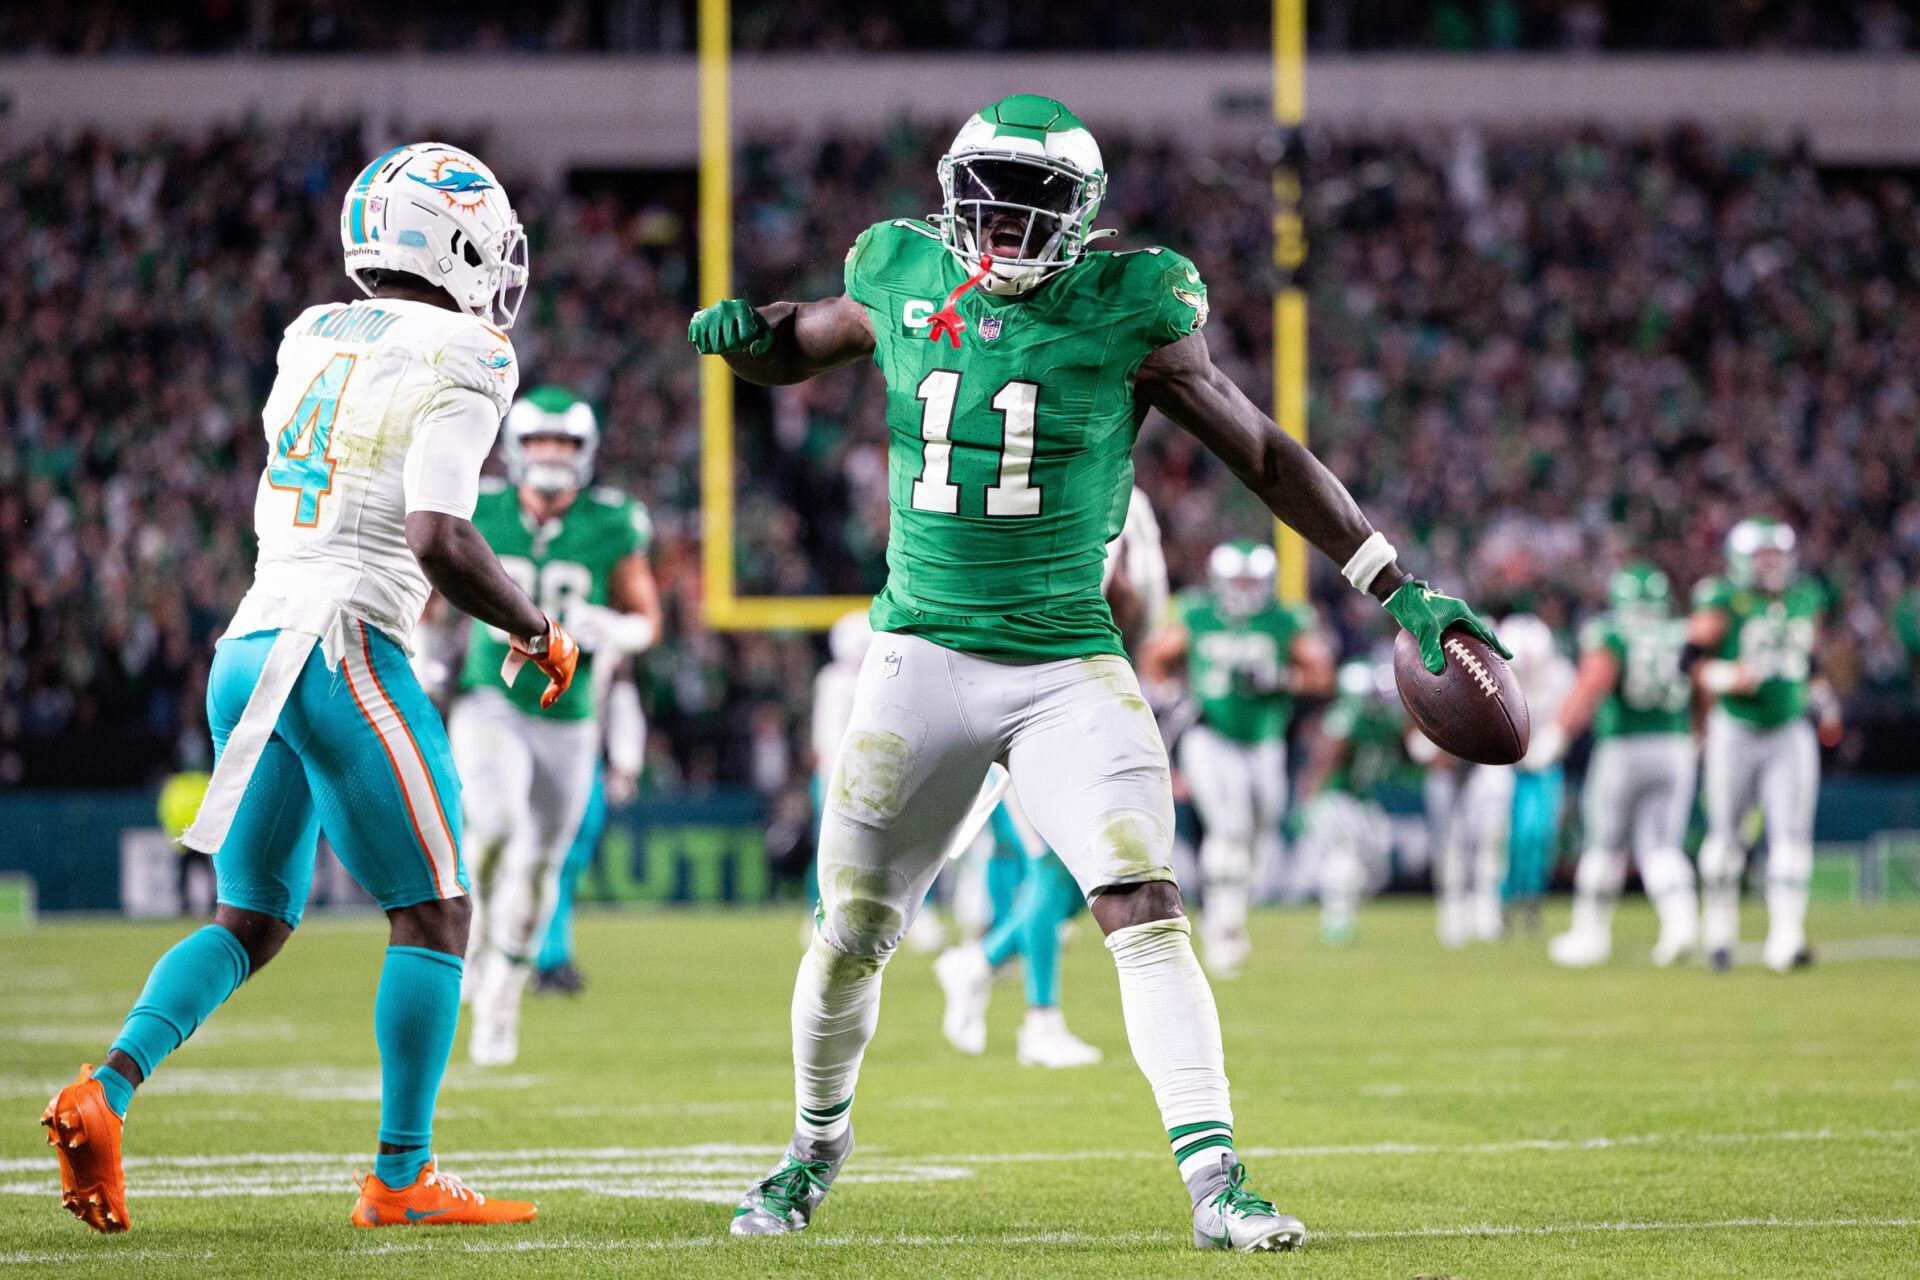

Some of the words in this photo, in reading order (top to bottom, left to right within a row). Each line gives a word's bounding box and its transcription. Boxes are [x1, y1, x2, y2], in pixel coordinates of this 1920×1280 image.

[305, 305, 404, 343] KOHOU
[903, 299, 935, 328] C
[267, 352, 358, 529] 4
[911, 367, 1044, 518] 11
